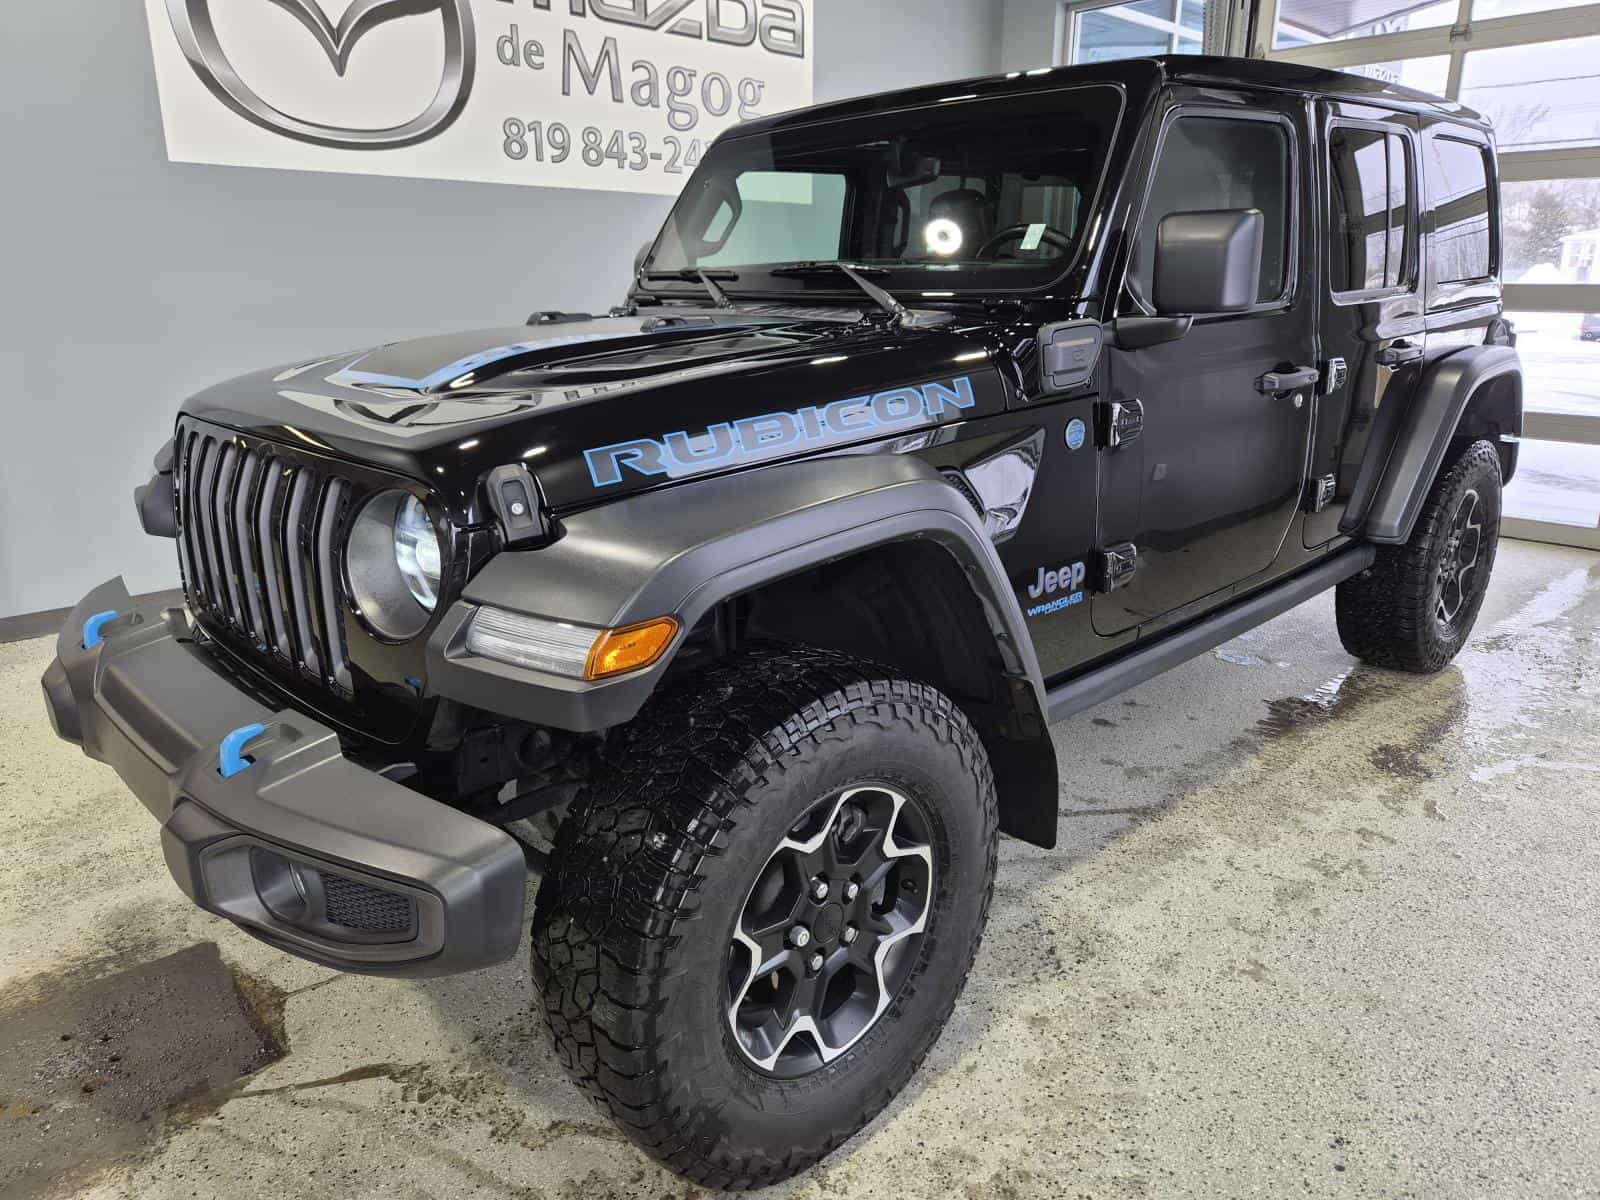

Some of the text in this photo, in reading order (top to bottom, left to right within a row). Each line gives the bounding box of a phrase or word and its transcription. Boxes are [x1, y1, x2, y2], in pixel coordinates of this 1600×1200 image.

[496, 23, 765, 132] de Magog
[502, 117, 712, 174] 819 843-24
[583, 376, 976, 488] RUBICON
[1027, 561, 1086, 599] Jeep
